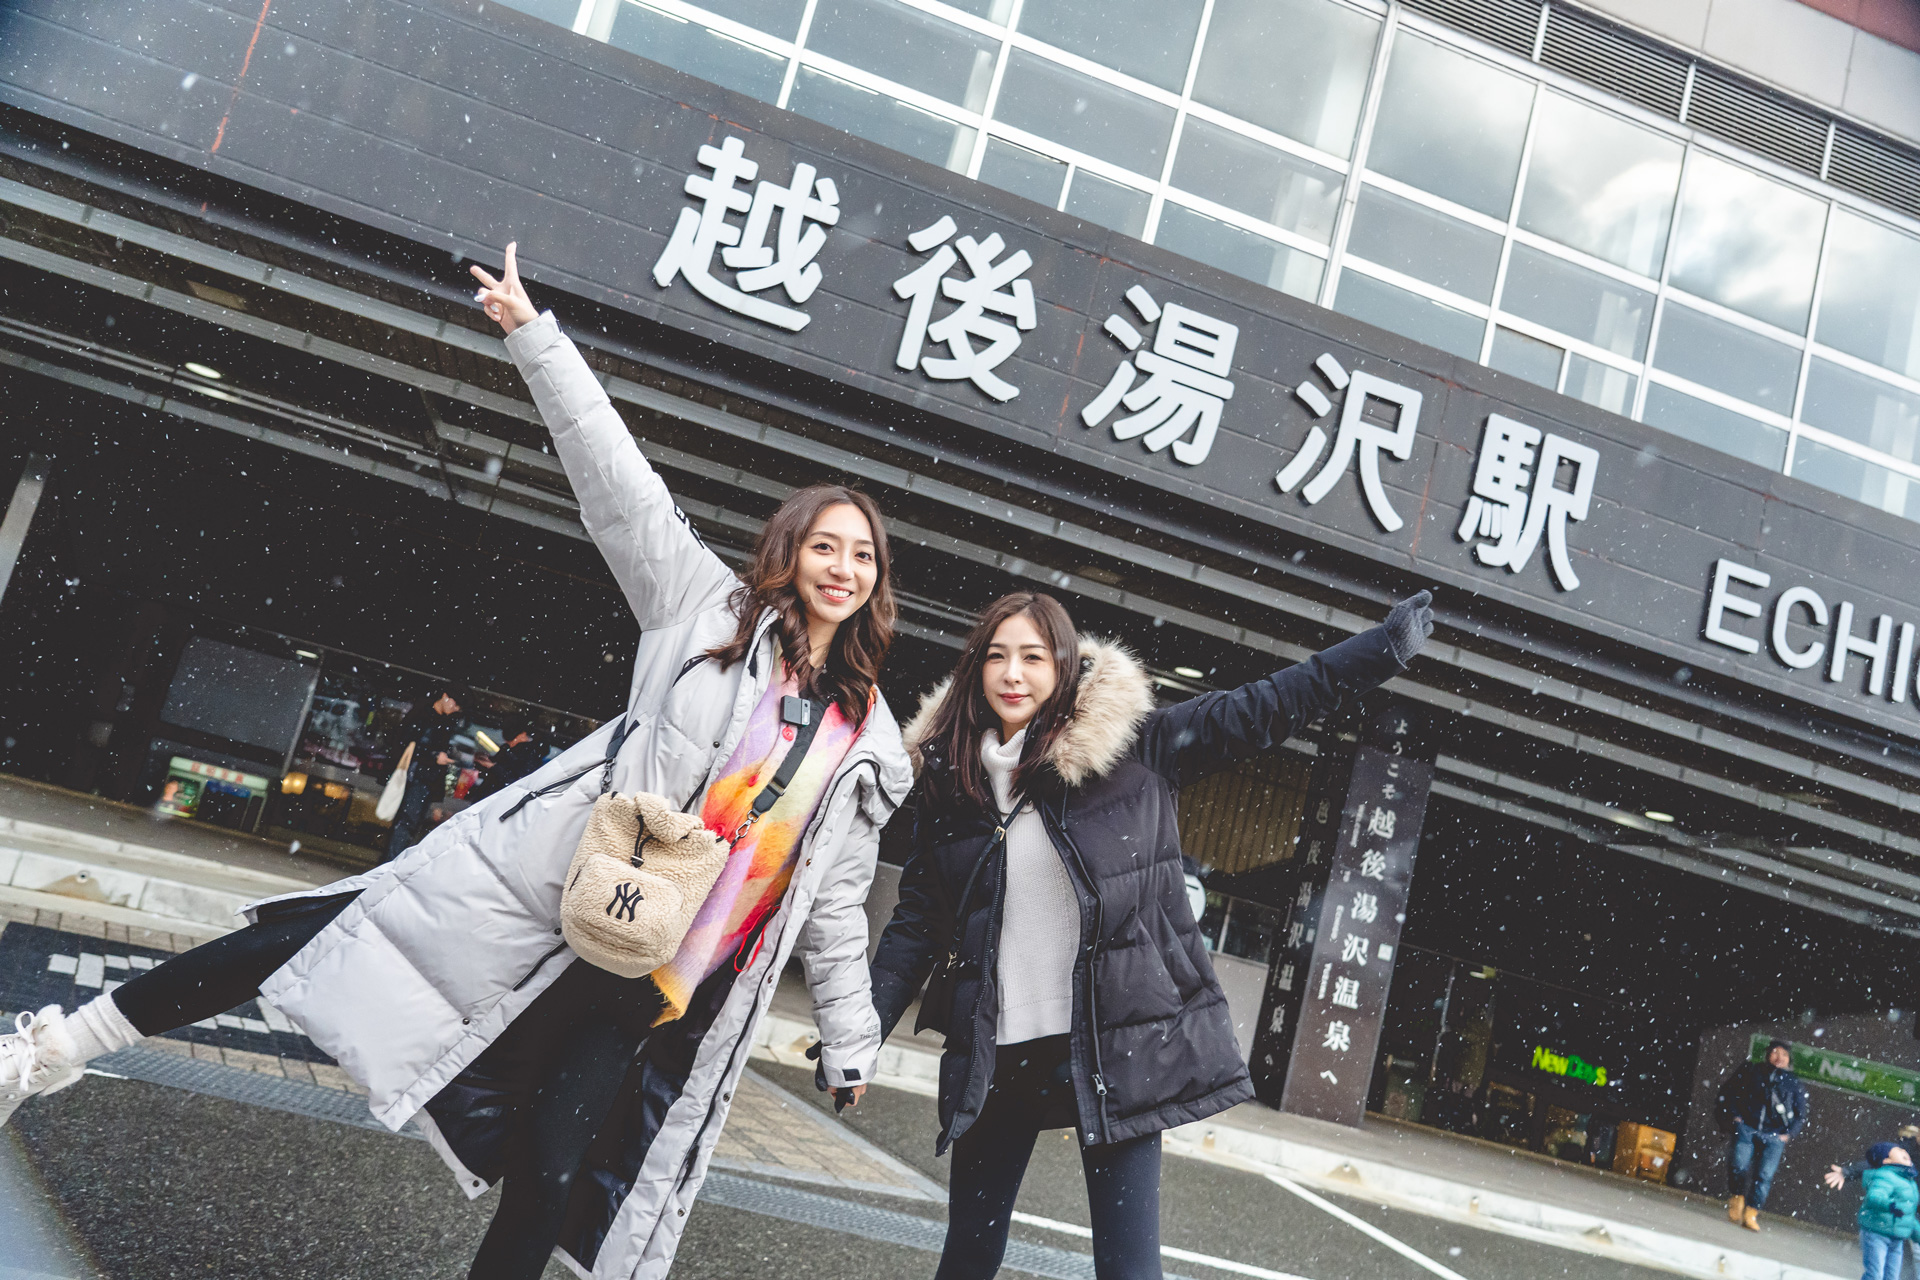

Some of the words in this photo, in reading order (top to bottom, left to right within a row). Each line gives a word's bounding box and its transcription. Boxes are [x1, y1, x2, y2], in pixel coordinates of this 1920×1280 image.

[653, 136, 1600, 592] 越後湯沢駅
[1705, 558, 1920, 703] ECHI
